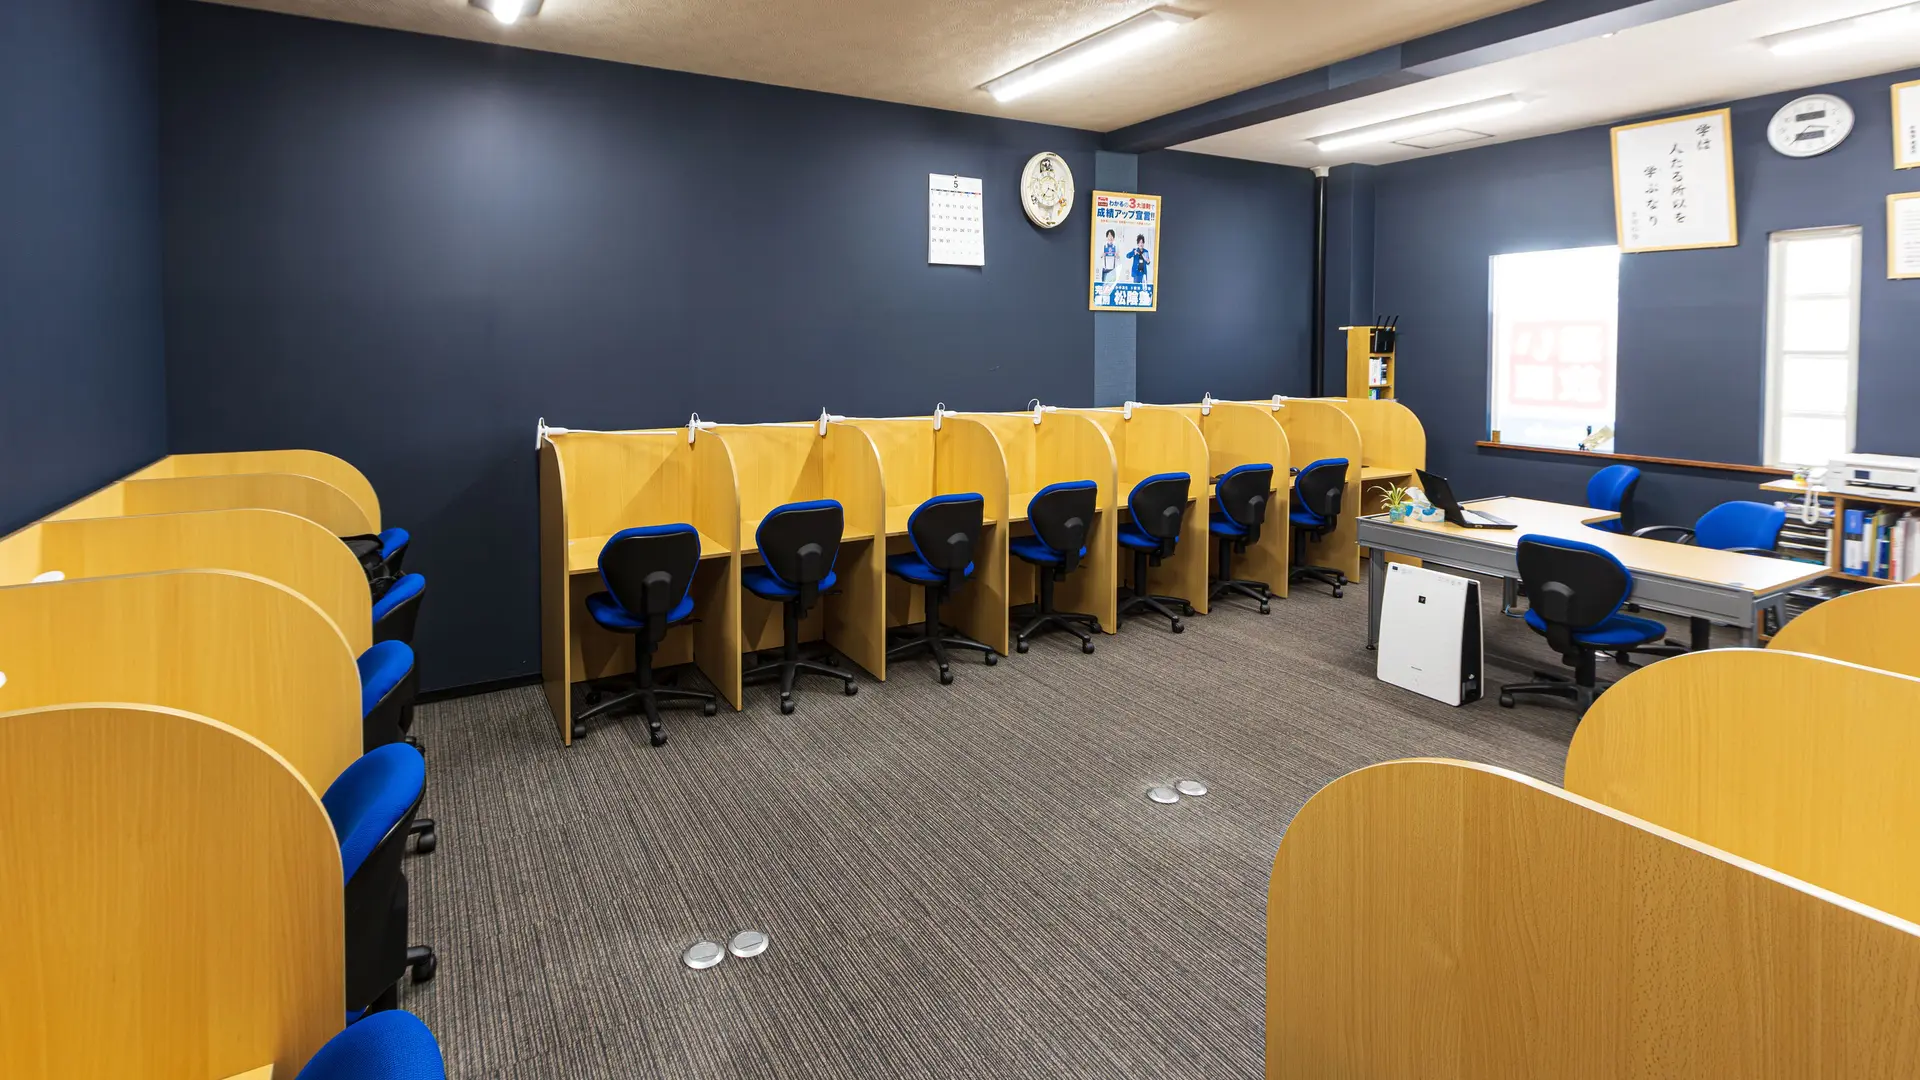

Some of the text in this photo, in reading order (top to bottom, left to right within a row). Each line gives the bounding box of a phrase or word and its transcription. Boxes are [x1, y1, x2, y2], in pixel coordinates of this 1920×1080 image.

[1695, 124, 1711, 150] 学は
[954, 180, 958, 188] 5
[1644, 165, 1659, 226] 学ぶなり
[1669, 143, 1687, 223] 人たる所以を
